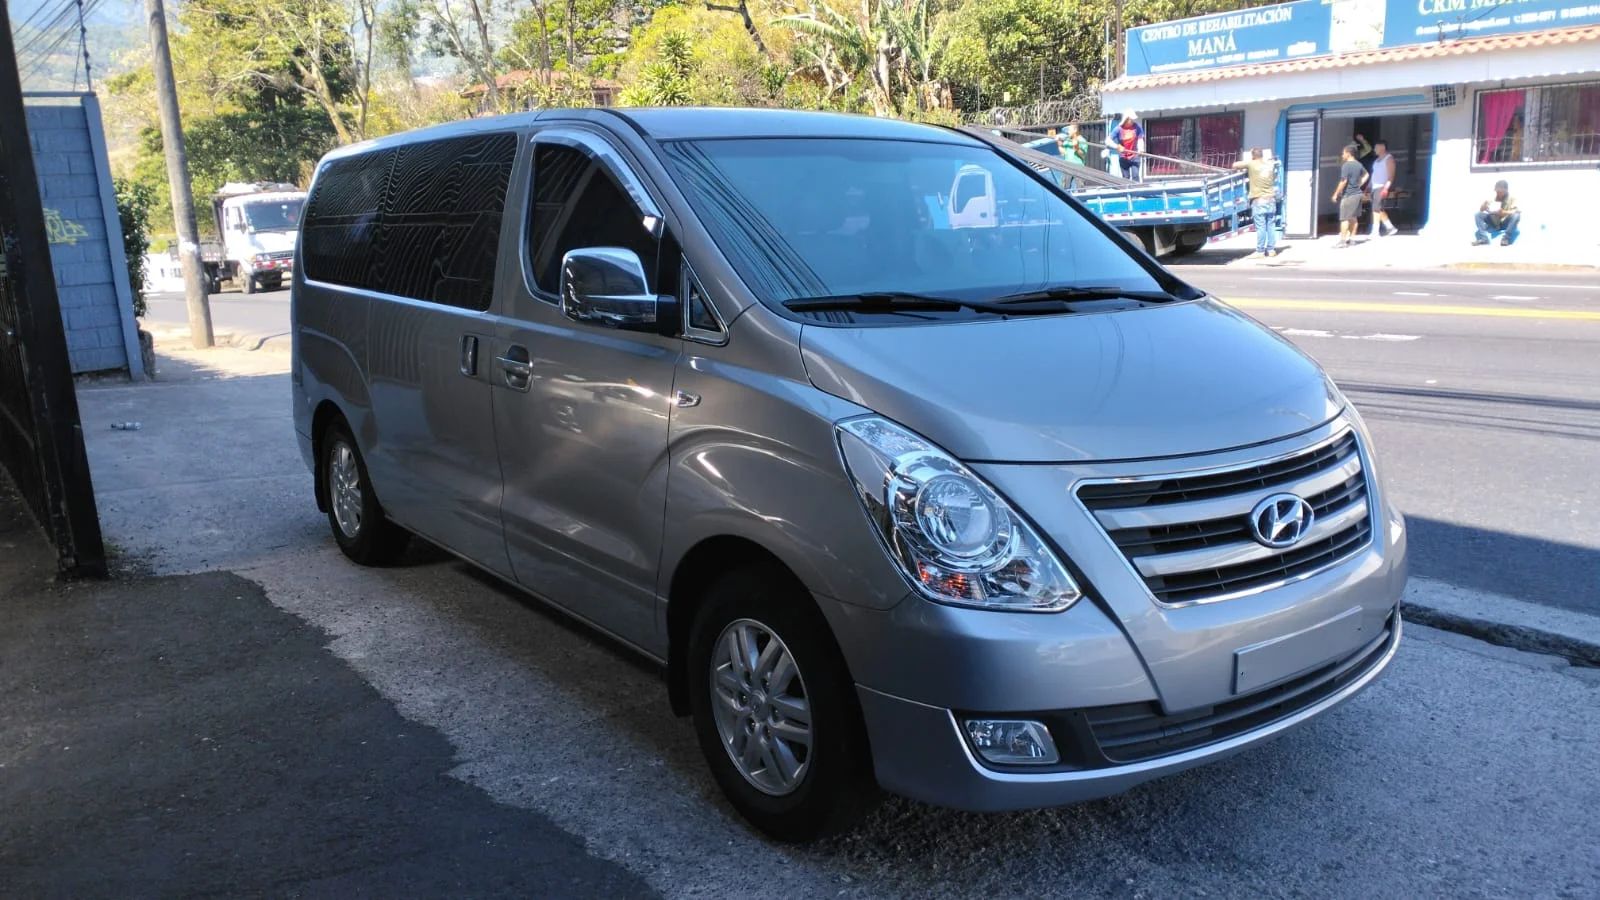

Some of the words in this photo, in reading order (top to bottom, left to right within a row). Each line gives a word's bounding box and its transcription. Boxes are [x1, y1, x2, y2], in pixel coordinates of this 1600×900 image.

[1141, 24, 1181, 42] CENTRO
[1182, 22, 1198, 37] DE
[1199, 5, 1293, 34] REHABILITACIÓN
[1188, 29, 1237, 57] MANÁ
